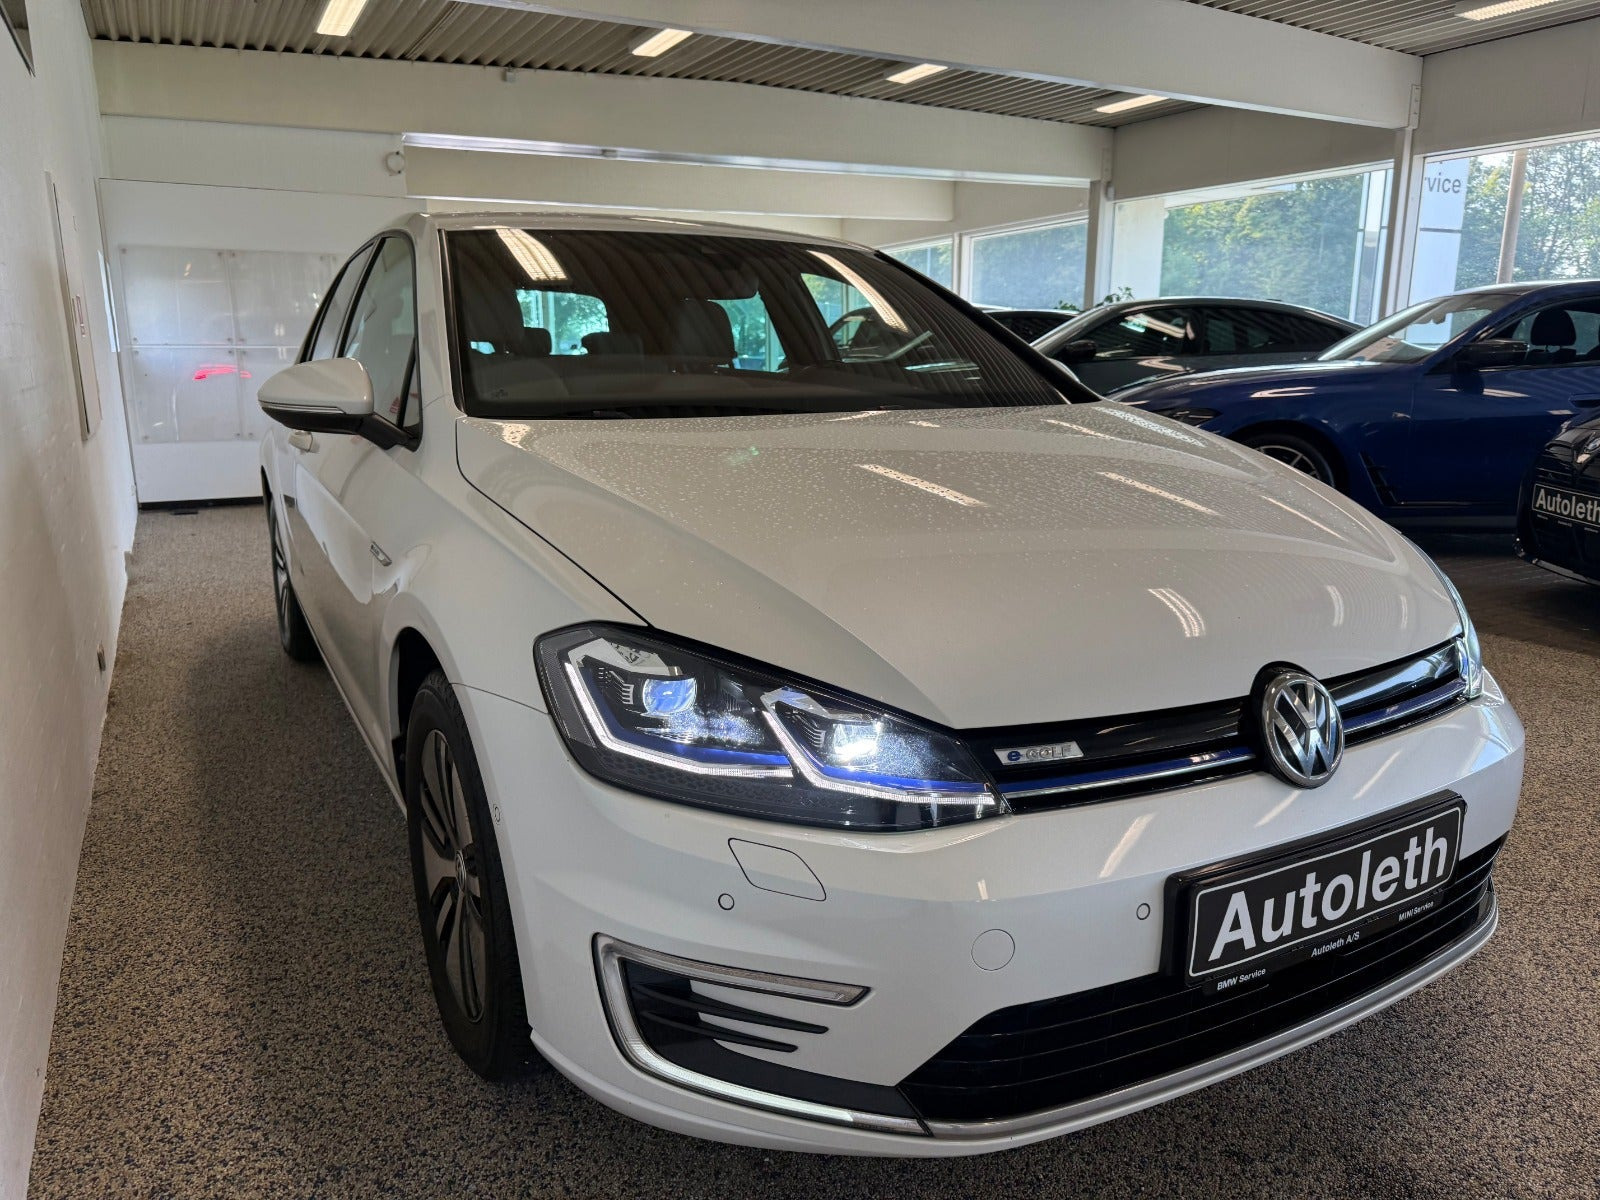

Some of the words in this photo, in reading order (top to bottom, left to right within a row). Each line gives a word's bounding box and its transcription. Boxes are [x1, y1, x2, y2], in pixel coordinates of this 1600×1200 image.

[1424, 171, 1461, 194] vice
[1535, 488, 1600, 524] Autoleth
[1207, 826, 1448, 962] Autoleth
[1311, 937, 1345, 957] Autoleth
[1345, 931, 1360, 944] A/S
[1217, 976, 1239, 991] BMW
[1239, 968, 1267, 983] Service
